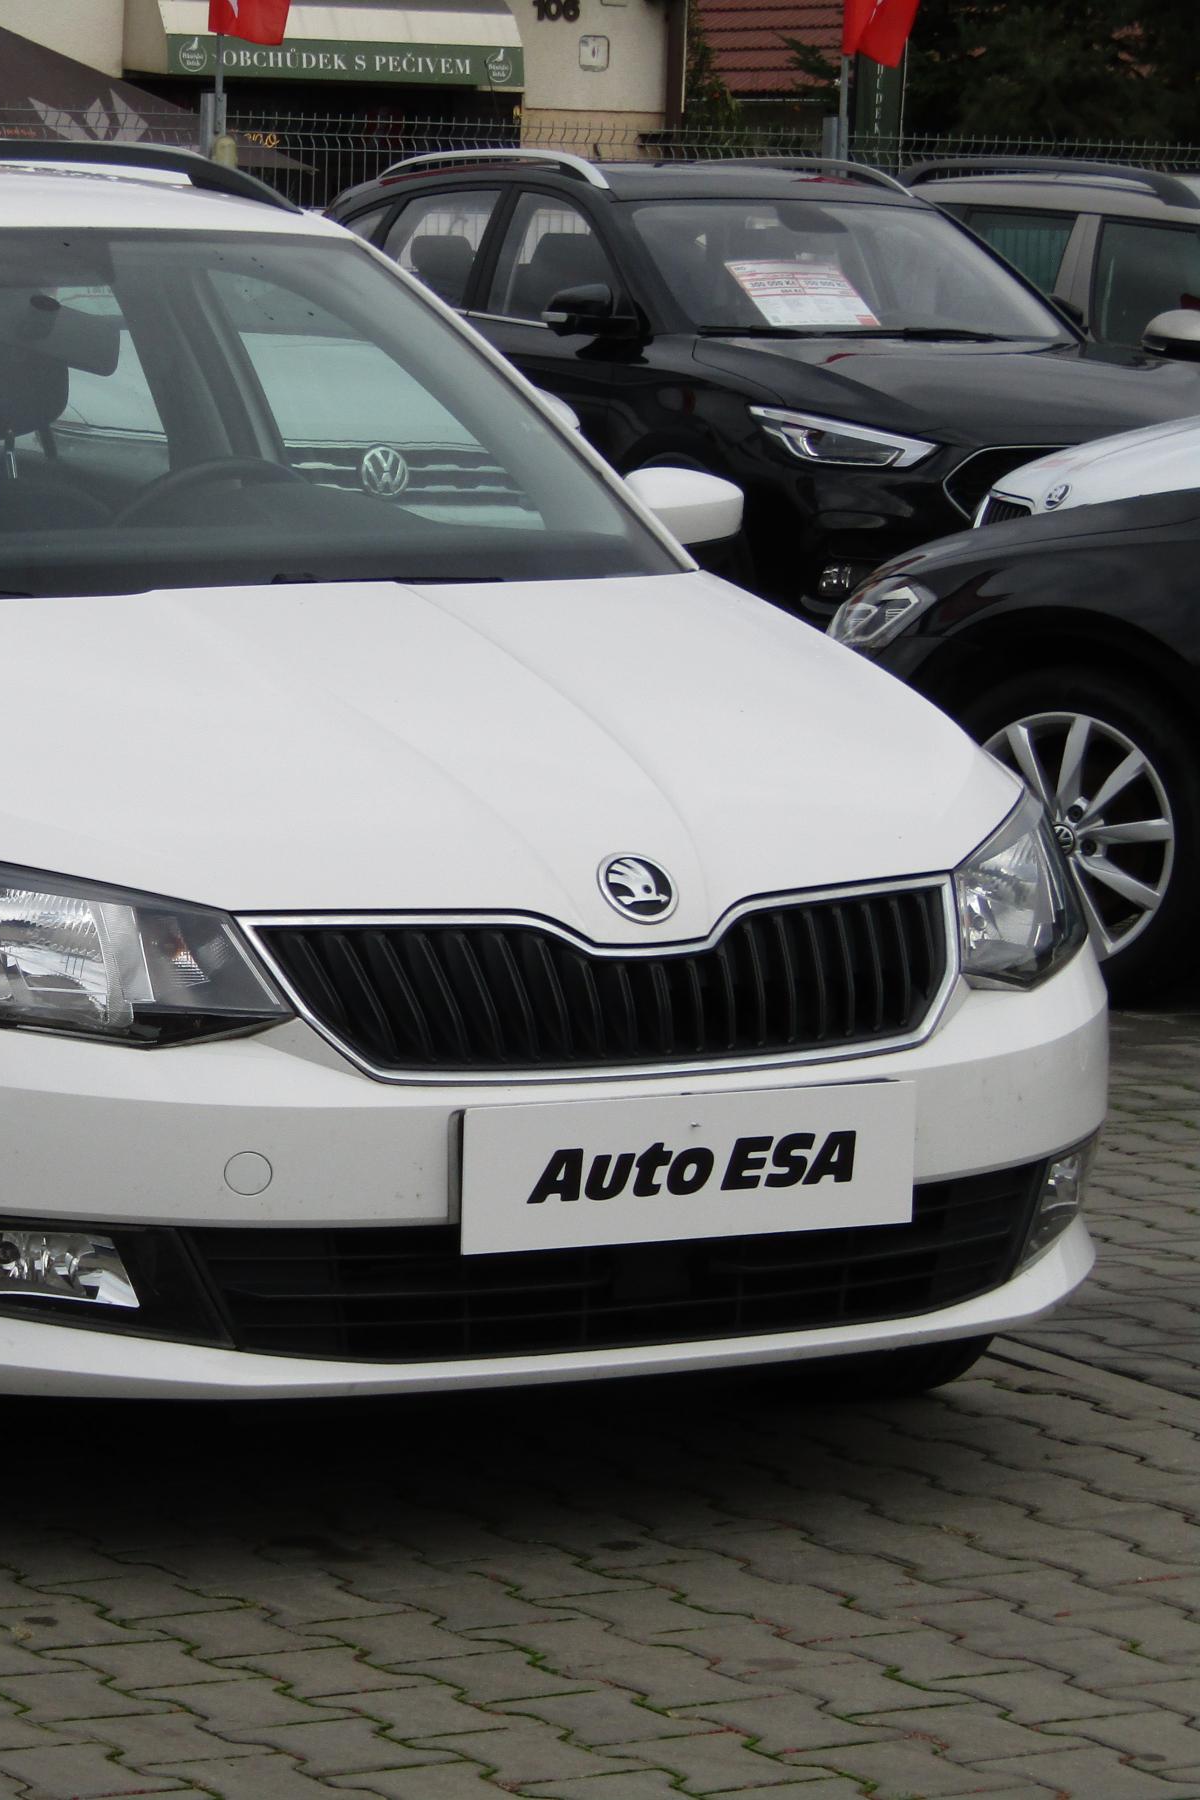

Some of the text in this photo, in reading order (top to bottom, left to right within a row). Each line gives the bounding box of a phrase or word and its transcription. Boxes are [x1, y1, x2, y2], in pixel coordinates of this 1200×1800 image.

[533, 0, 580, 22] 106
[222, 48, 348, 71] OBCHŮDEK
[354, 54, 366, 72] S
[374, 52, 471, 75] PEČIVEM
[526, 1130, 857, 1205] Auto ESA
